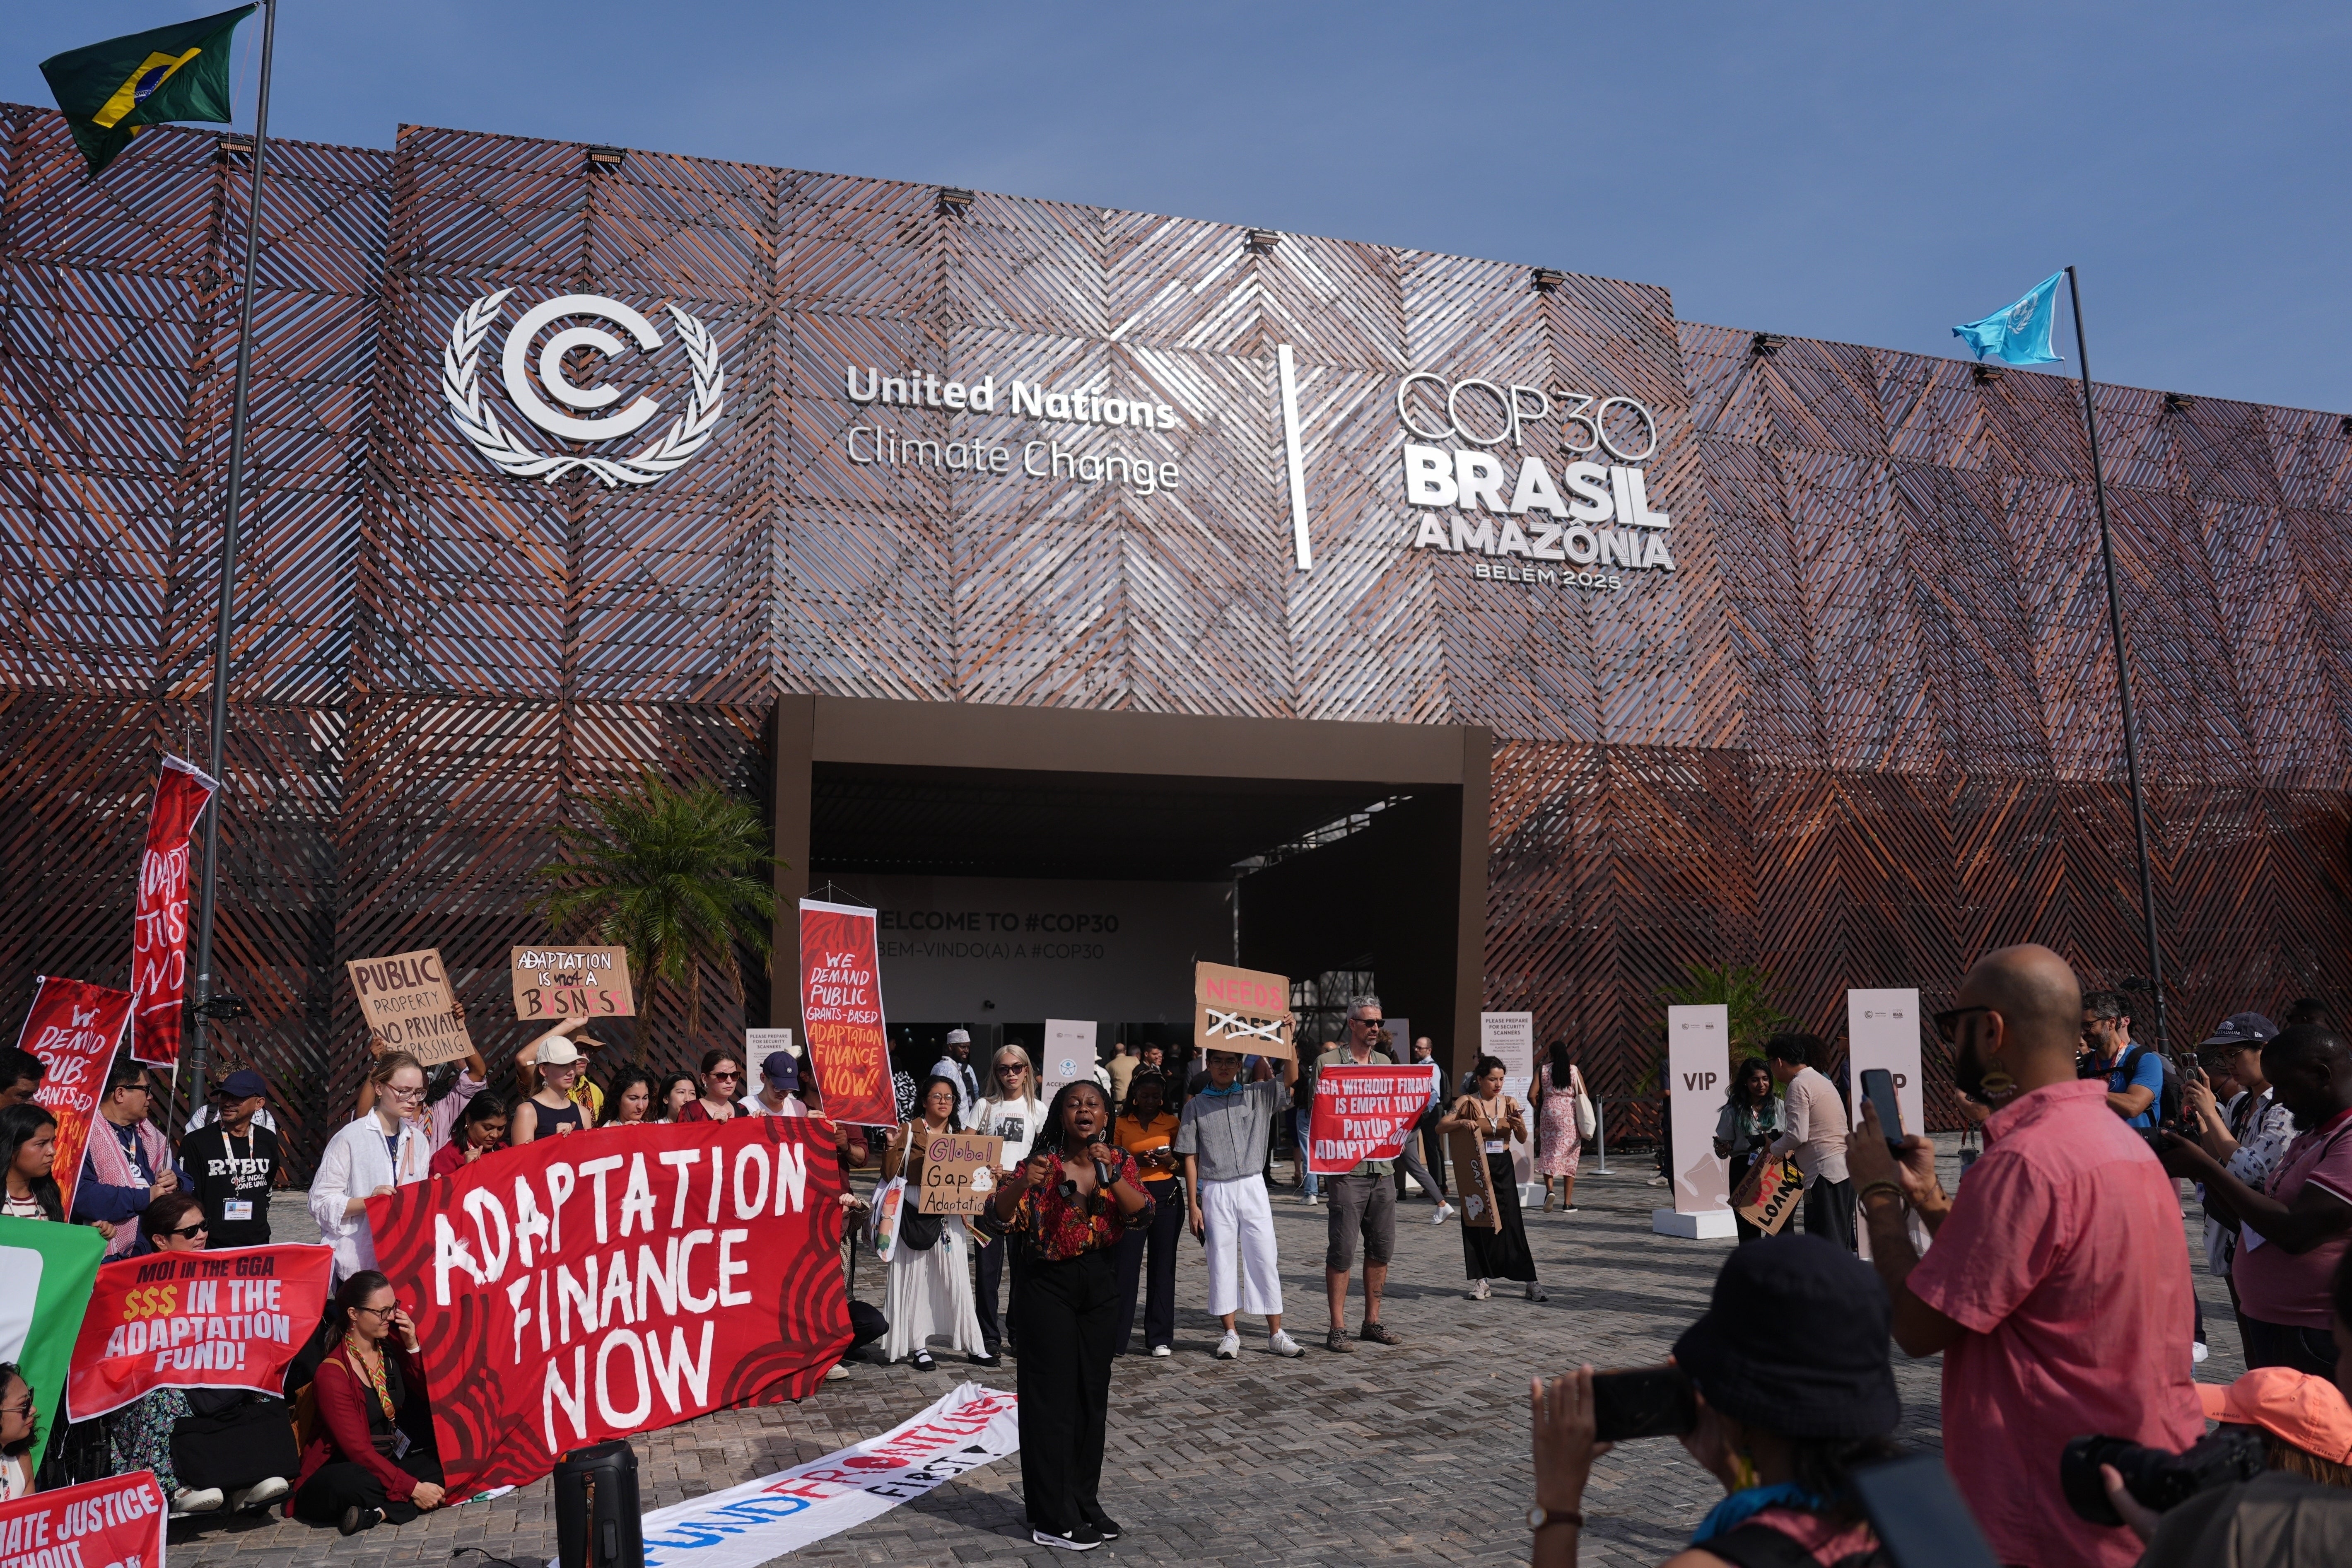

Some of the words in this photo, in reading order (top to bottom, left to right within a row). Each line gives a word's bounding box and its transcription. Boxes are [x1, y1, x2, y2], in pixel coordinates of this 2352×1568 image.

[847, 365, 994, 413] United
[1011, 380, 1176, 430] Nations
[1397, 373, 1656, 461] COP30
[848, 425, 1010, 473] Climate
[1023, 440, 1179, 496] Change
[1404, 443, 1670, 528] BRASIL
[1414, 512, 1676, 571] AMAZÔNIA
[1475, 563, 1555, 584] BELÉM
[1563, 572, 1621, 590] 2025
[140, 840, 189, 911] ADAPT
[136, 900, 189, 953] JUS
[879, 911, 981, 931] ELCOME
[985, 912, 1019, 931] TO
[1025, 913, 1119, 933] #COP30
[517, 950, 612, 970] ADAPTATION
[826, 952, 855, 968] WE
[1014, 943, 1027, 958] A
[1032, 943, 1105, 959] #COP30
[355, 955, 440, 995] PUBLIC
[538, 971, 551, 987] IS
[554, 970, 584, 987] not
[585, 970, 598, 987] A
[810, 967, 870, 986] DEMAND
[374, 991, 439, 1014] PROPERTY
[522, 989, 627, 1017] BUSINESS
[811, 984, 867, 1006] PUBLIC
[1206, 977, 1283, 1011] NEEDS
[373, 1022, 403, 1044] NO
[405, 1012, 463, 1040] PRIVATE
[806, 1006, 878, 1024] GRANTS-BASED
[808, 1022, 882, 1046] ADAPTATION
[815, 1043, 878, 1067] FINANCE
[823, 1066, 880, 1097] NOW!
[1342, 1078, 1394, 1095] WITHOUT
[1683, 1072, 1717, 1091] VIP
[1335, 1097, 1346, 1114] IS
[1350, 1096, 1393, 1114] EMPTY
[929, 1138, 992, 1162] Global
[208, 1158, 270, 1176] RTBU
[927, 1165, 967, 1194] Gap
[1471, 1159, 1484, 1189] GAP
[1751, 1165, 1781, 1208] NOT
[924, 1192, 984, 1214] Adaptatio
[1757, 1179, 1795, 1227] LOAN
[433, 1142, 807, 1306] ADAPTATION
[136, 1259, 176, 1284] MOI
[180, 1261, 197, 1279] IN
[202, 1260, 230, 1277] THE
[235, 1257, 275, 1277] GGA
[123, 1284, 178, 1322] $$$
[187, 1280, 217, 1314] IN
[228, 1280, 281, 1313] THE
[505, 1228, 752, 1365] FINANCE
[105, 1310, 289, 1358] ADAPTATION
[154, 1340, 245, 1373] FUND!
[543, 1320, 714, 1455] NOW
[2312, 1447, 2341, 1459] ARTENGO
[56, 1484, 159, 1541] JUSTICE
